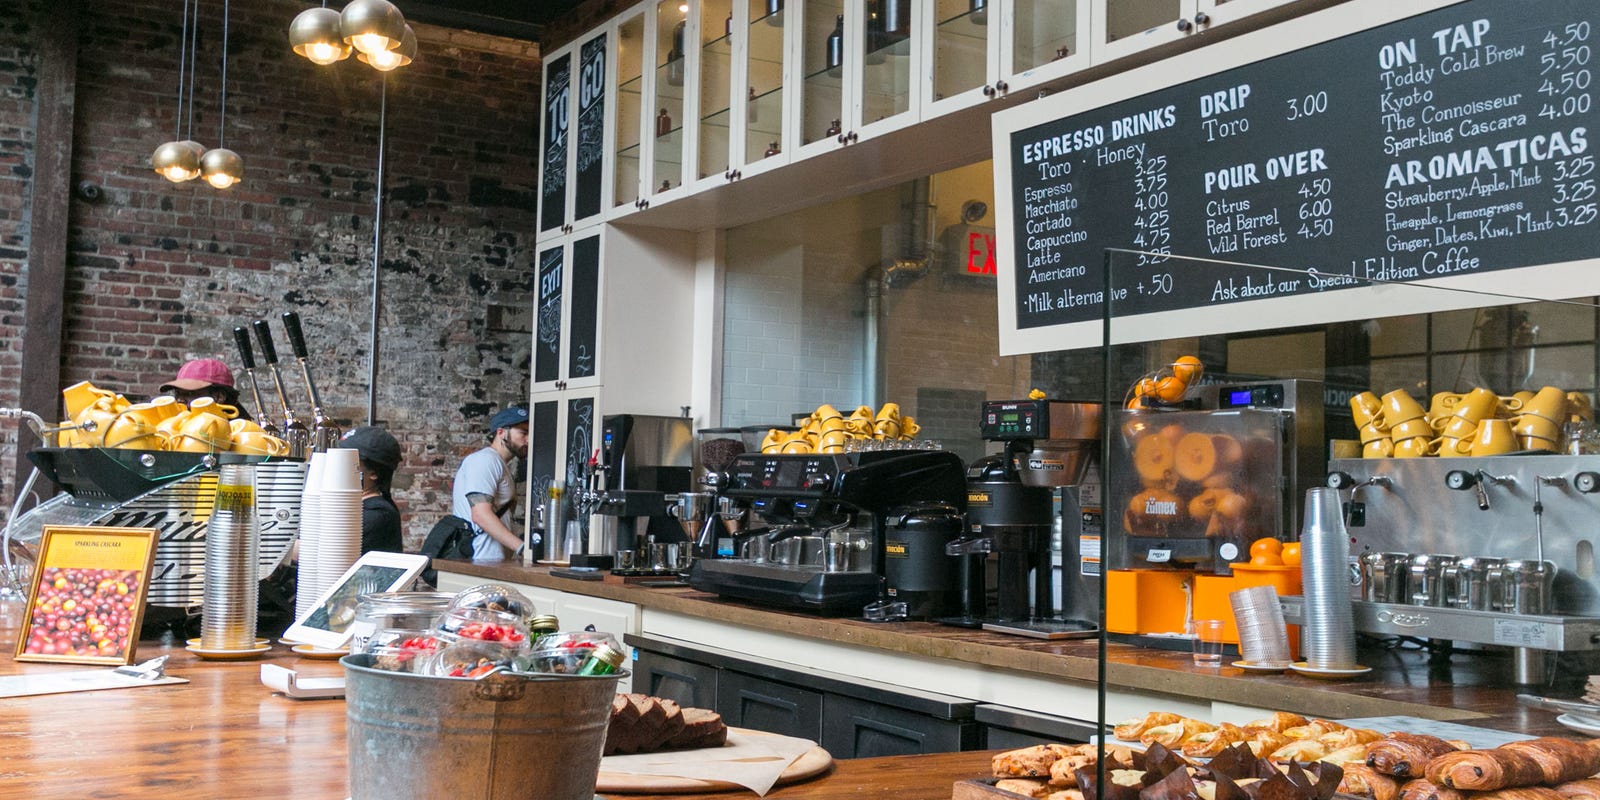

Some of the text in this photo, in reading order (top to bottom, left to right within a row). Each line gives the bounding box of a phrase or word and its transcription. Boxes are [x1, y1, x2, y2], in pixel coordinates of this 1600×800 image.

[1378, 18, 1491, 70] ON TAP
[1380, 21, 1591, 91] Toddy Cold Brew 4.50
[581, 51, 604, 110] GO
[1200, 84, 1251, 119] DRIP
[1381, 45, 1591, 113] Kyoto 5.50
[1382, 69, 1591, 133] The Connoisseur 4.50
[549, 86, 569, 143] TO
[1023, 105, 1176, 164] ESPRESSO DRINKS
[1202, 91, 1328, 143] Toro 3.00
[1383, 93, 1591, 157] Sparkling Cascara 4.00
[1024, 155, 1167, 203] Espresso 3.25
[1038, 142, 1146, 181] Toro Honey
[1204, 148, 1328, 194] POUR OVER
[1384, 126, 1588, 189] AROMATICAS
[1552, 155, 1595, 182] 3.25
[1025, 173, 1168, 219] Macchiato 3.75
[1026, 191, 1169, 235] Cortado 4.00
[1206, 178, 1331, 217] Citrus 4.50
[1206, 198, 1332, 236] Red Barrel 6.00
[1446, 201, 1524, 224] Lemongrass
[1552, 179, 1596, 205] 3.25
[1027, 209, 1170, 254] Cappuccino 4.25
[1207, 218, 1333, 255] Wild Forest 4.50
[1516, 210, 1554, 235] Mint
[1554, 203, 1598, 228] 3.25
[968, 232, 997, 275] EX
[1027, 227, 1171, 269] Latte 4.75
[541, 263, 562, 300] EXIT
[1028, 264, 1086, 284] Americano
[1211, 247, 1480, 302] Ask about our Special Edition Coffee
[1056, 287, 1127, 309] alternaive
